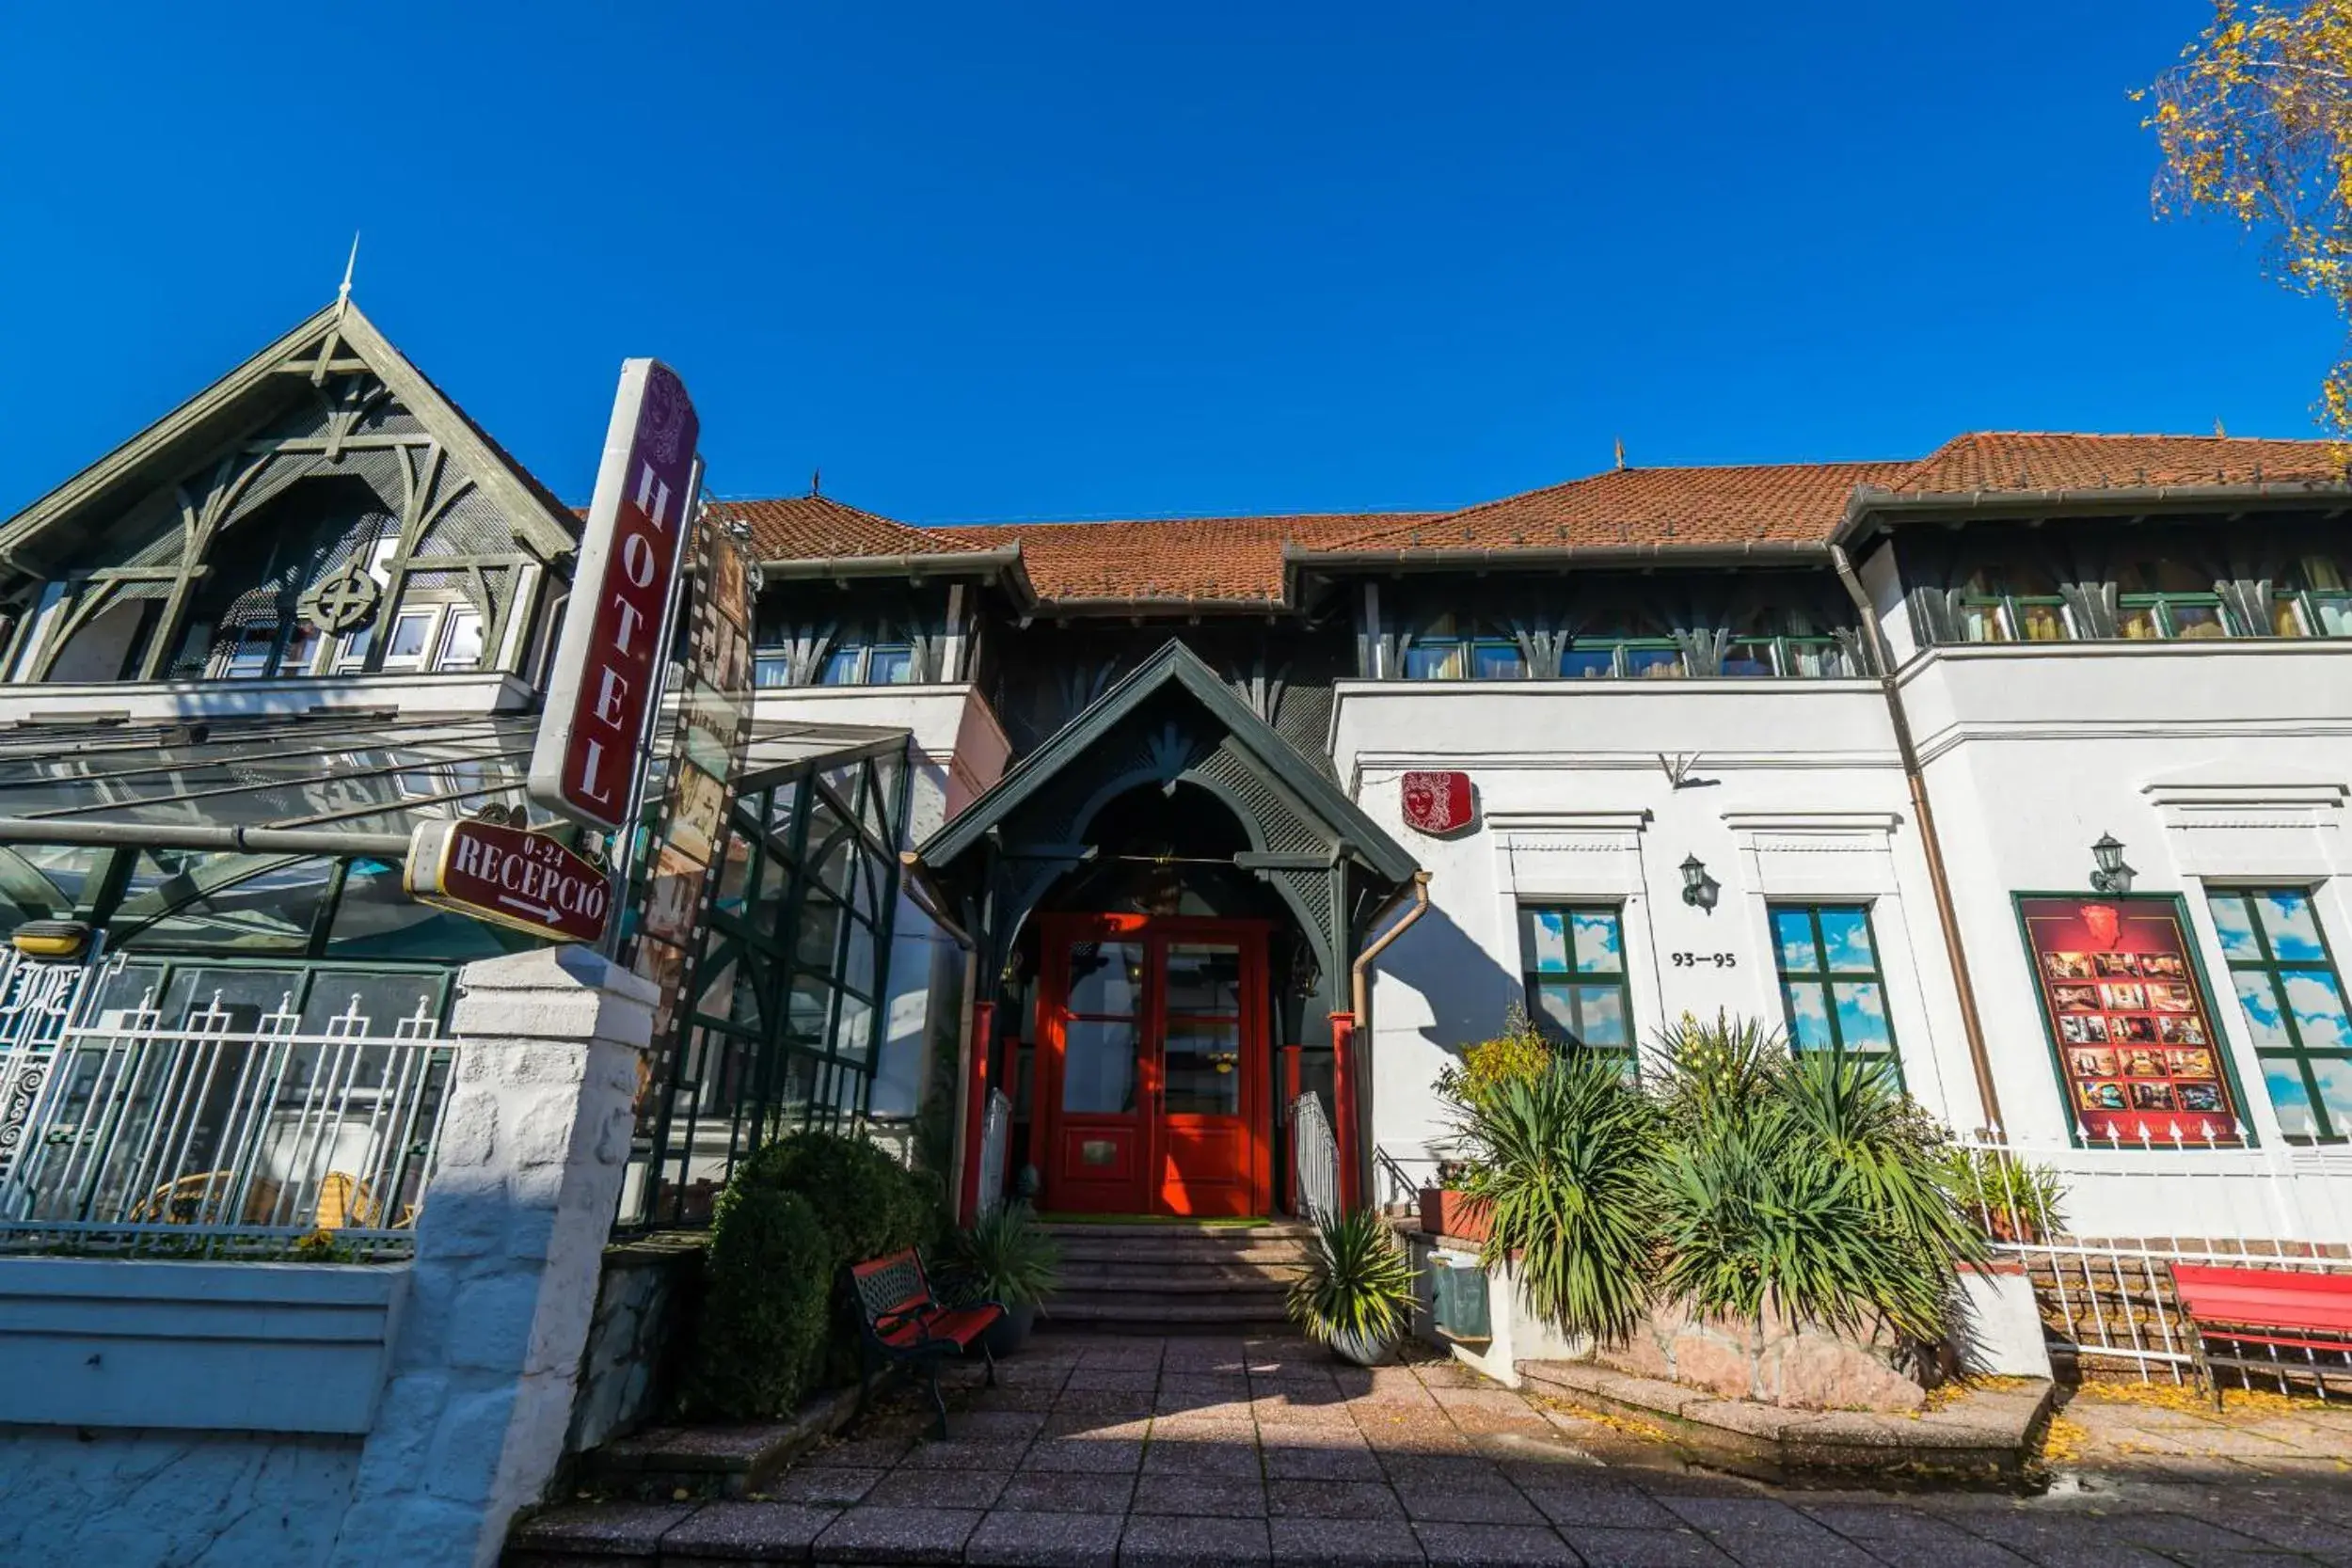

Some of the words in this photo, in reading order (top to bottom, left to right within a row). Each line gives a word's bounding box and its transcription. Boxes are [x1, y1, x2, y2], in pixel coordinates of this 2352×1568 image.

[580, 458, 672, 804] HOTEL
[453, 834, 604, 919] RECEPCIÓ
[524, 835, 563, 868] 0-24
